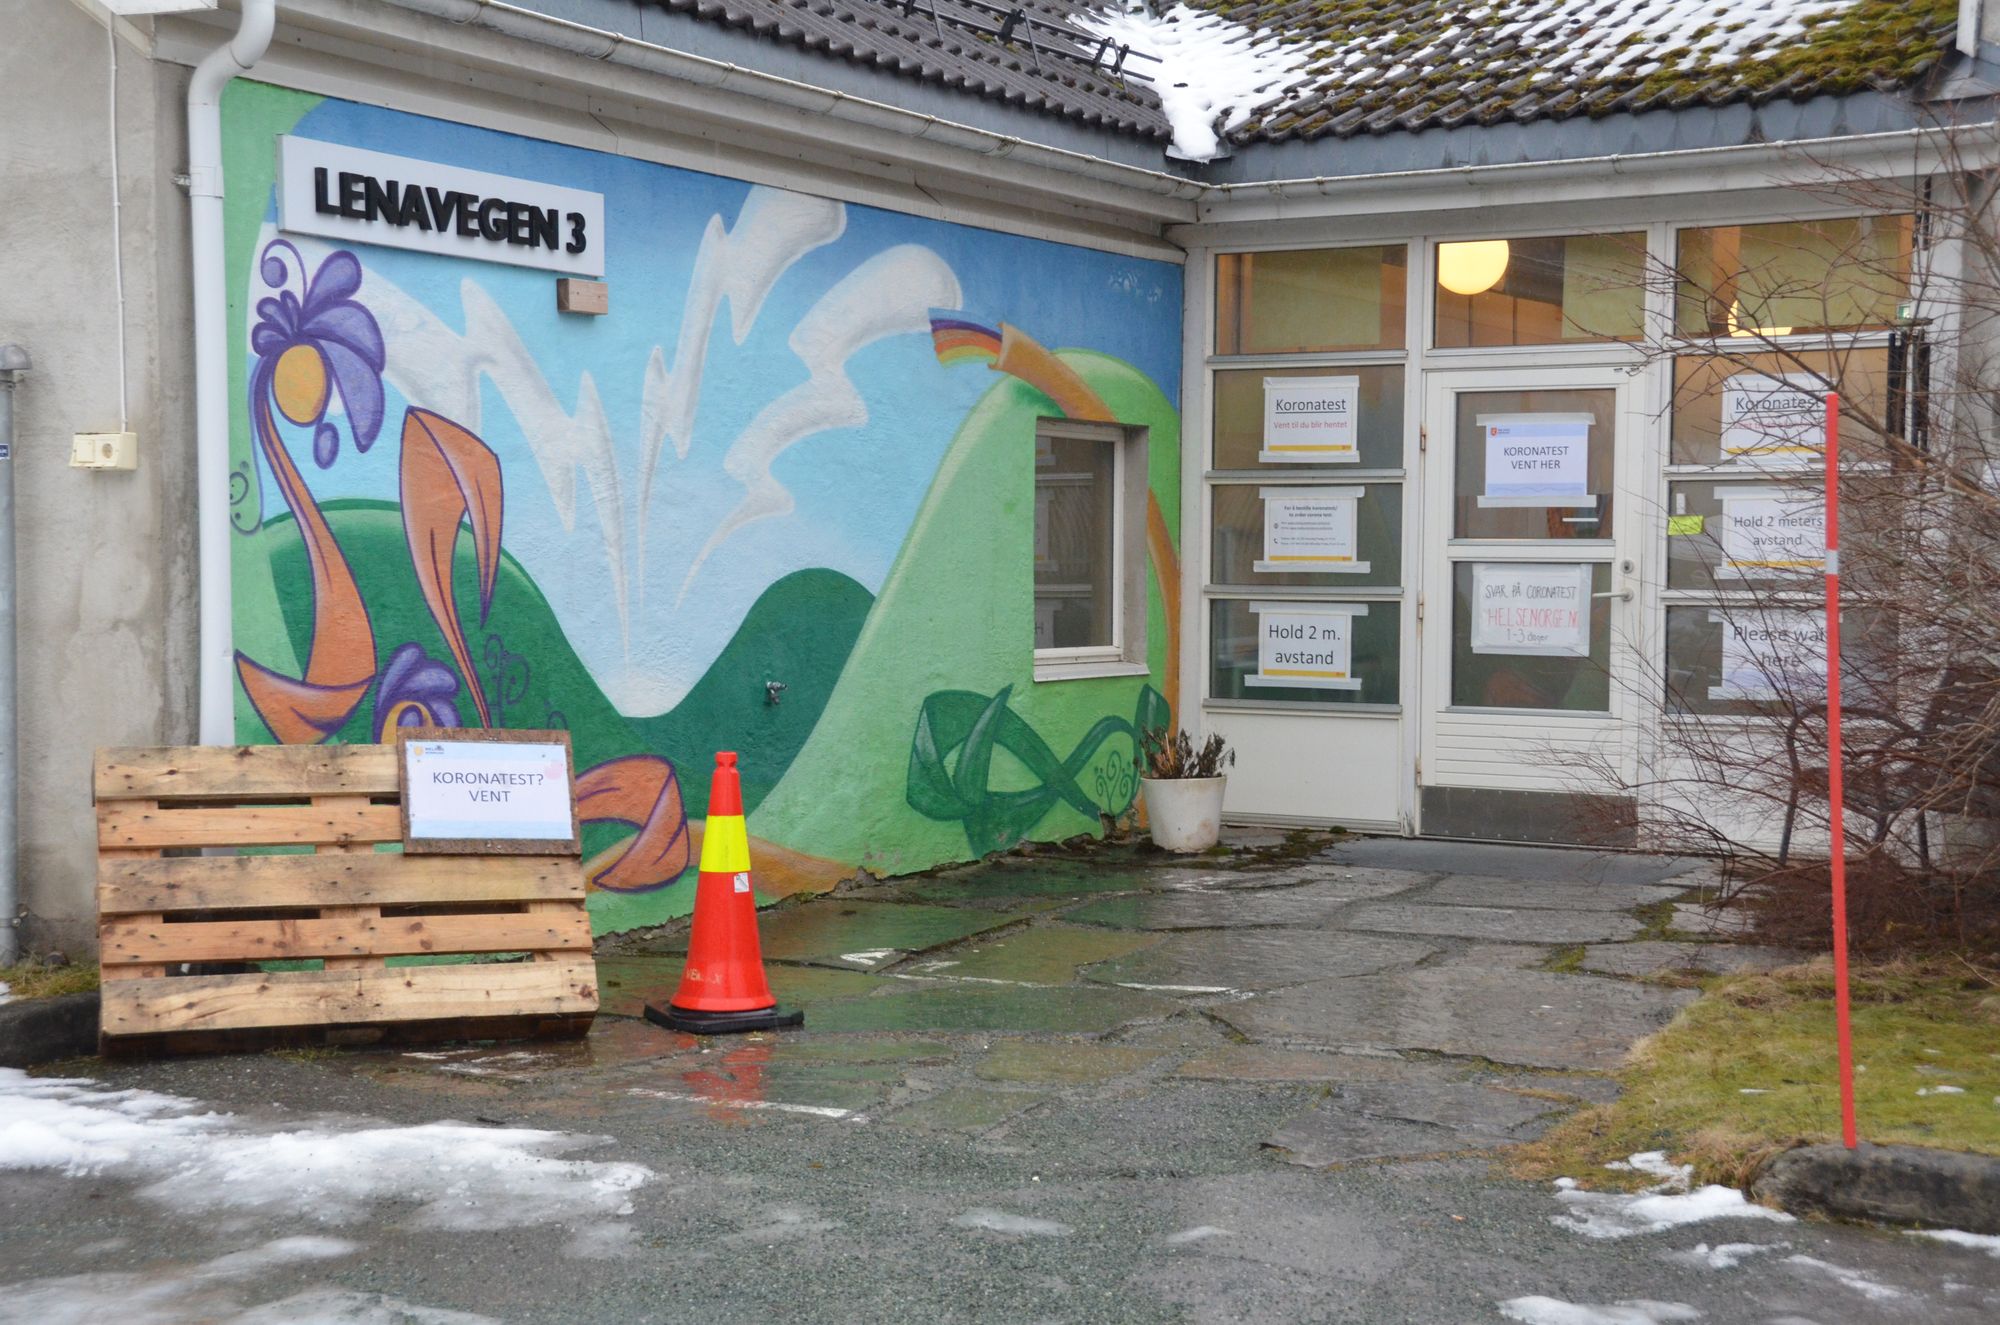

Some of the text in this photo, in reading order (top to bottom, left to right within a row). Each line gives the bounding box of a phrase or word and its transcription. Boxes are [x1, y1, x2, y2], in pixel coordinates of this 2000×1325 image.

[313, 166, 588, 254] LENAVEGEN 3
[1275, 399, 1347, 412] Koronatest
[1735, 397, 1821, 411] Koronatest
[1273, 420, 1348, 430] Vent til du blir hentet
[1503, 445, 1569, 457] KORONATEST
[1511, 459, 1561, 470] VENT HER
[1733, 516, 1824, 528] Hold 2 meters
[1752, 534, 1803, 546] avstand
[1485, 582, 1577, 600] SVAR PÅ CORONATEST
[1268, 624, 1341, 641] Hold 2 m.
[1506, 628, 1526, 643] 1-3
[1732, 626, 1788, 641] Please
[1275, 650, 1334, 665] avstand
[1760, 652, 1802, 668] here
[432, 771, 545, 786] KORONATEST?
[468, 790, 512, 803] VENT
